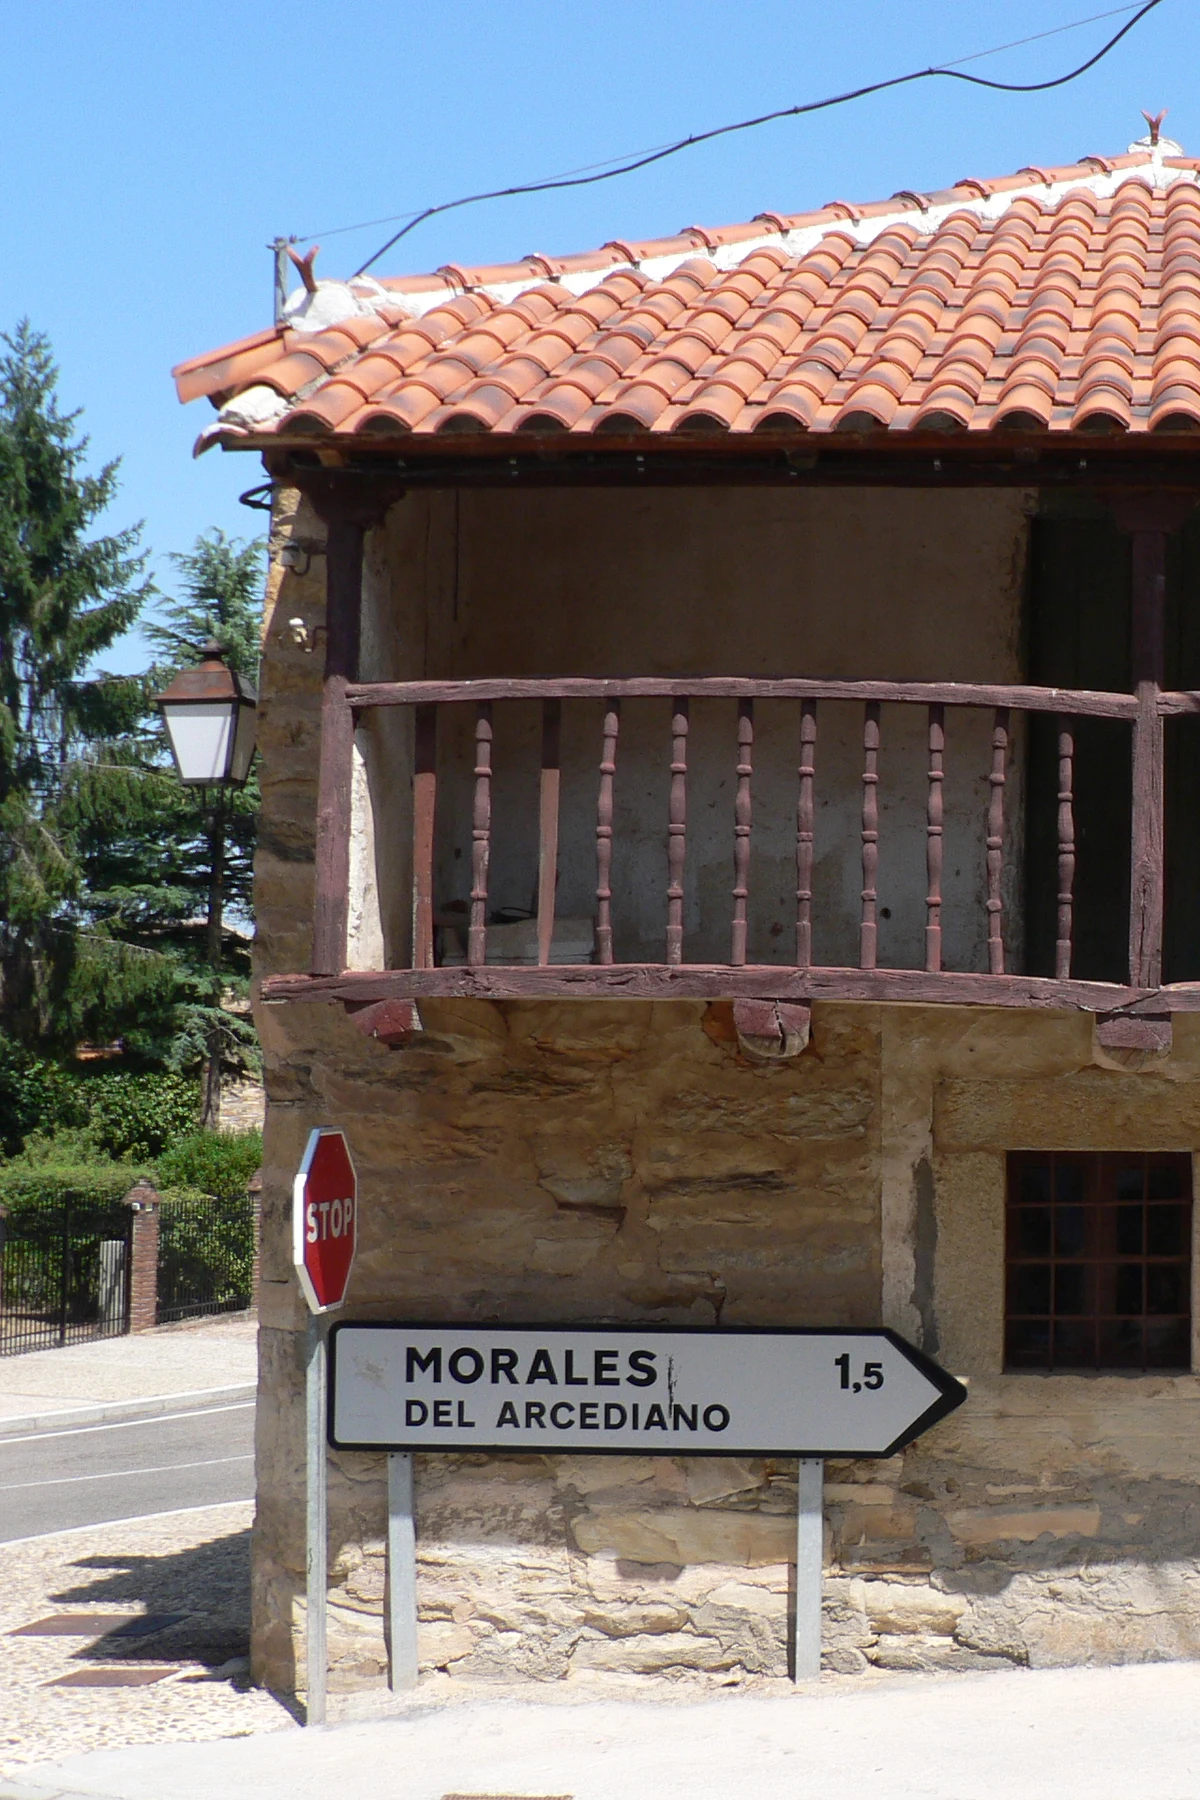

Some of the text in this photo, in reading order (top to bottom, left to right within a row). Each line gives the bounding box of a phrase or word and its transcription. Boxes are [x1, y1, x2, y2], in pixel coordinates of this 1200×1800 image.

[306, 1197, 353, 1244] STOP
[405, 1346, 658, 1388] MORALES
[834, 1352, 886, 1394] 1,5
[405, 1399, 731, 1433] DEL ARCEDIANO
